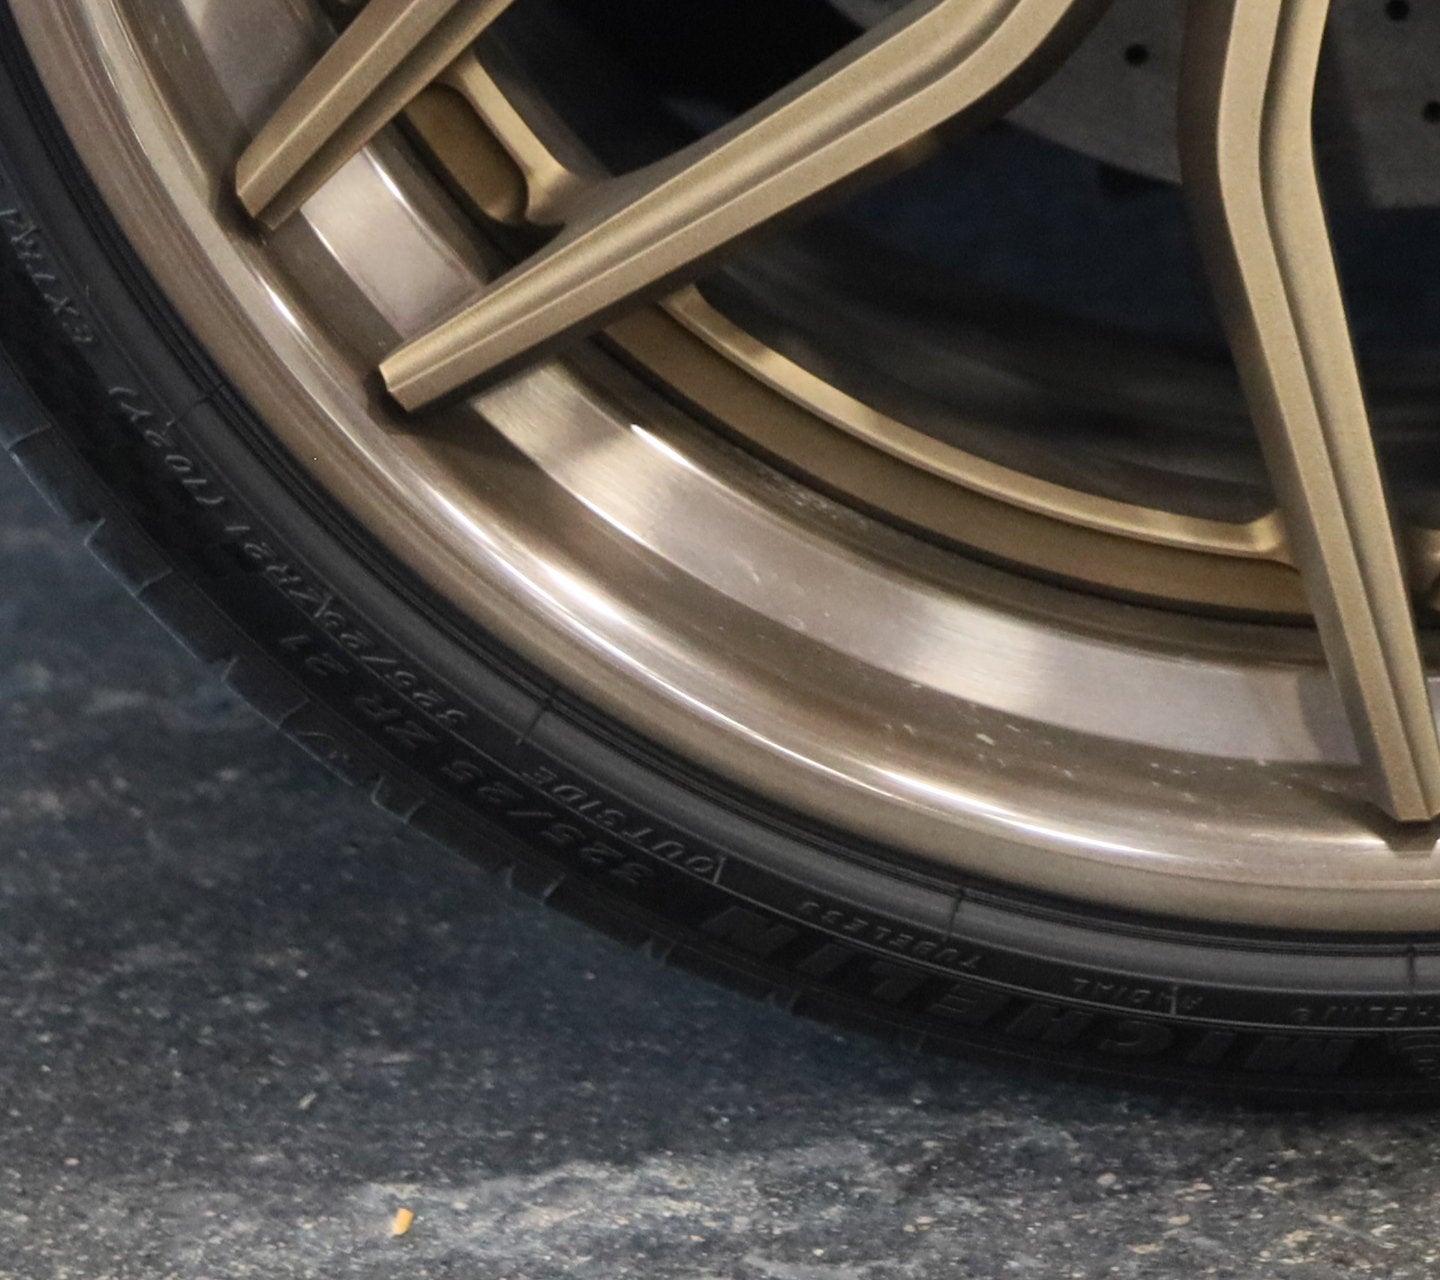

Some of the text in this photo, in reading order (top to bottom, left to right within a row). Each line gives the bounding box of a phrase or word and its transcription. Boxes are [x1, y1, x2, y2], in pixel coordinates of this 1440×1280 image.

[274, 619, 655, 892] 325/25 ZR 21
[519, 756, 717, 878] OUTSIDE
[698, 893, 1353, 1076] MICHELIN
